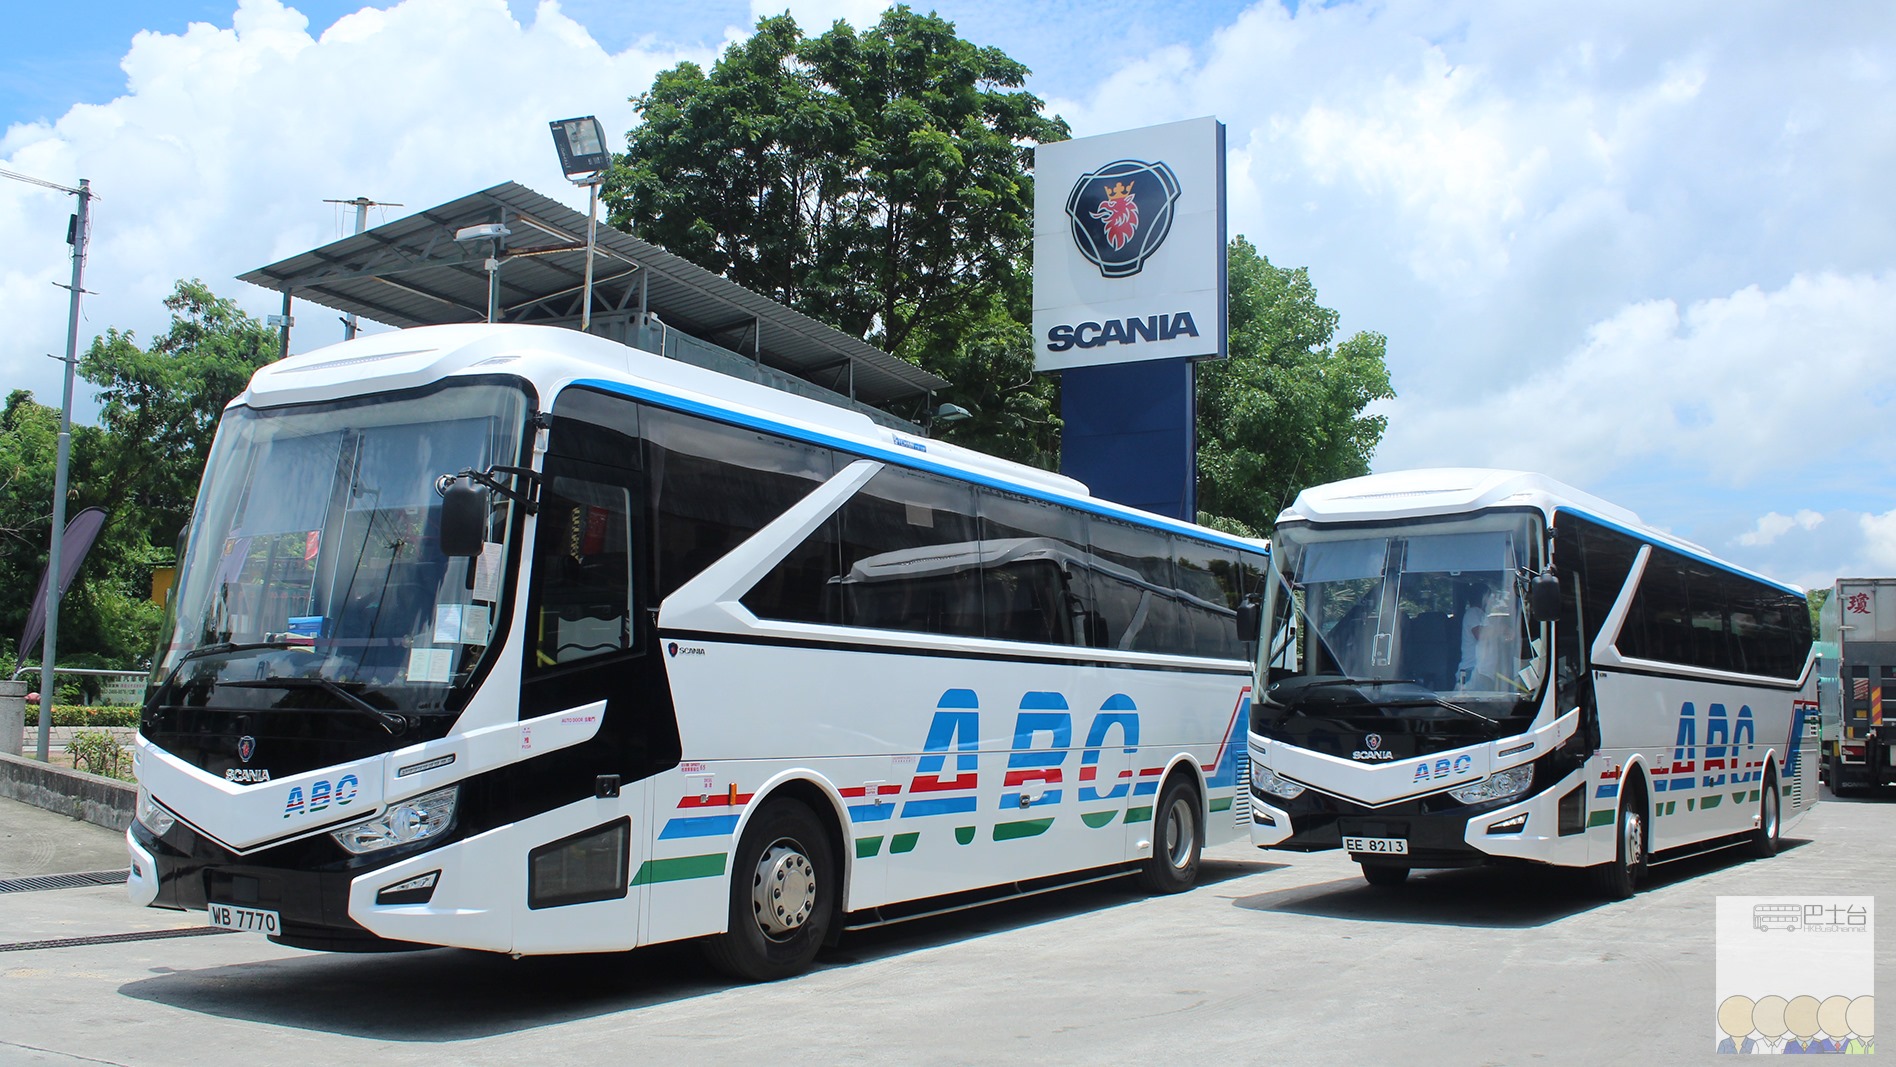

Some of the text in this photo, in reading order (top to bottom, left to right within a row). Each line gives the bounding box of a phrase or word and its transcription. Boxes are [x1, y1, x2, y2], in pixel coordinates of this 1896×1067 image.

[1046, 311, 1200, 352] SCANIA
[1846, 592, 1872, 614] 瓊
[679, 646, 706, 656] SCANIA
[1352, 750, 1394, 760] SCANIA
[1666, 701, 1755, 816] ABC
[225, 768, 271, 782] SCANIA
[889, 688, 1140, 853] ABC
[1413, 754, 1471, 784] ABC
[284, 774, 359, 819] ABC
[1346, 838, 1404, 852] EE 8213
[212, 906, 276, 932] WB 7770
